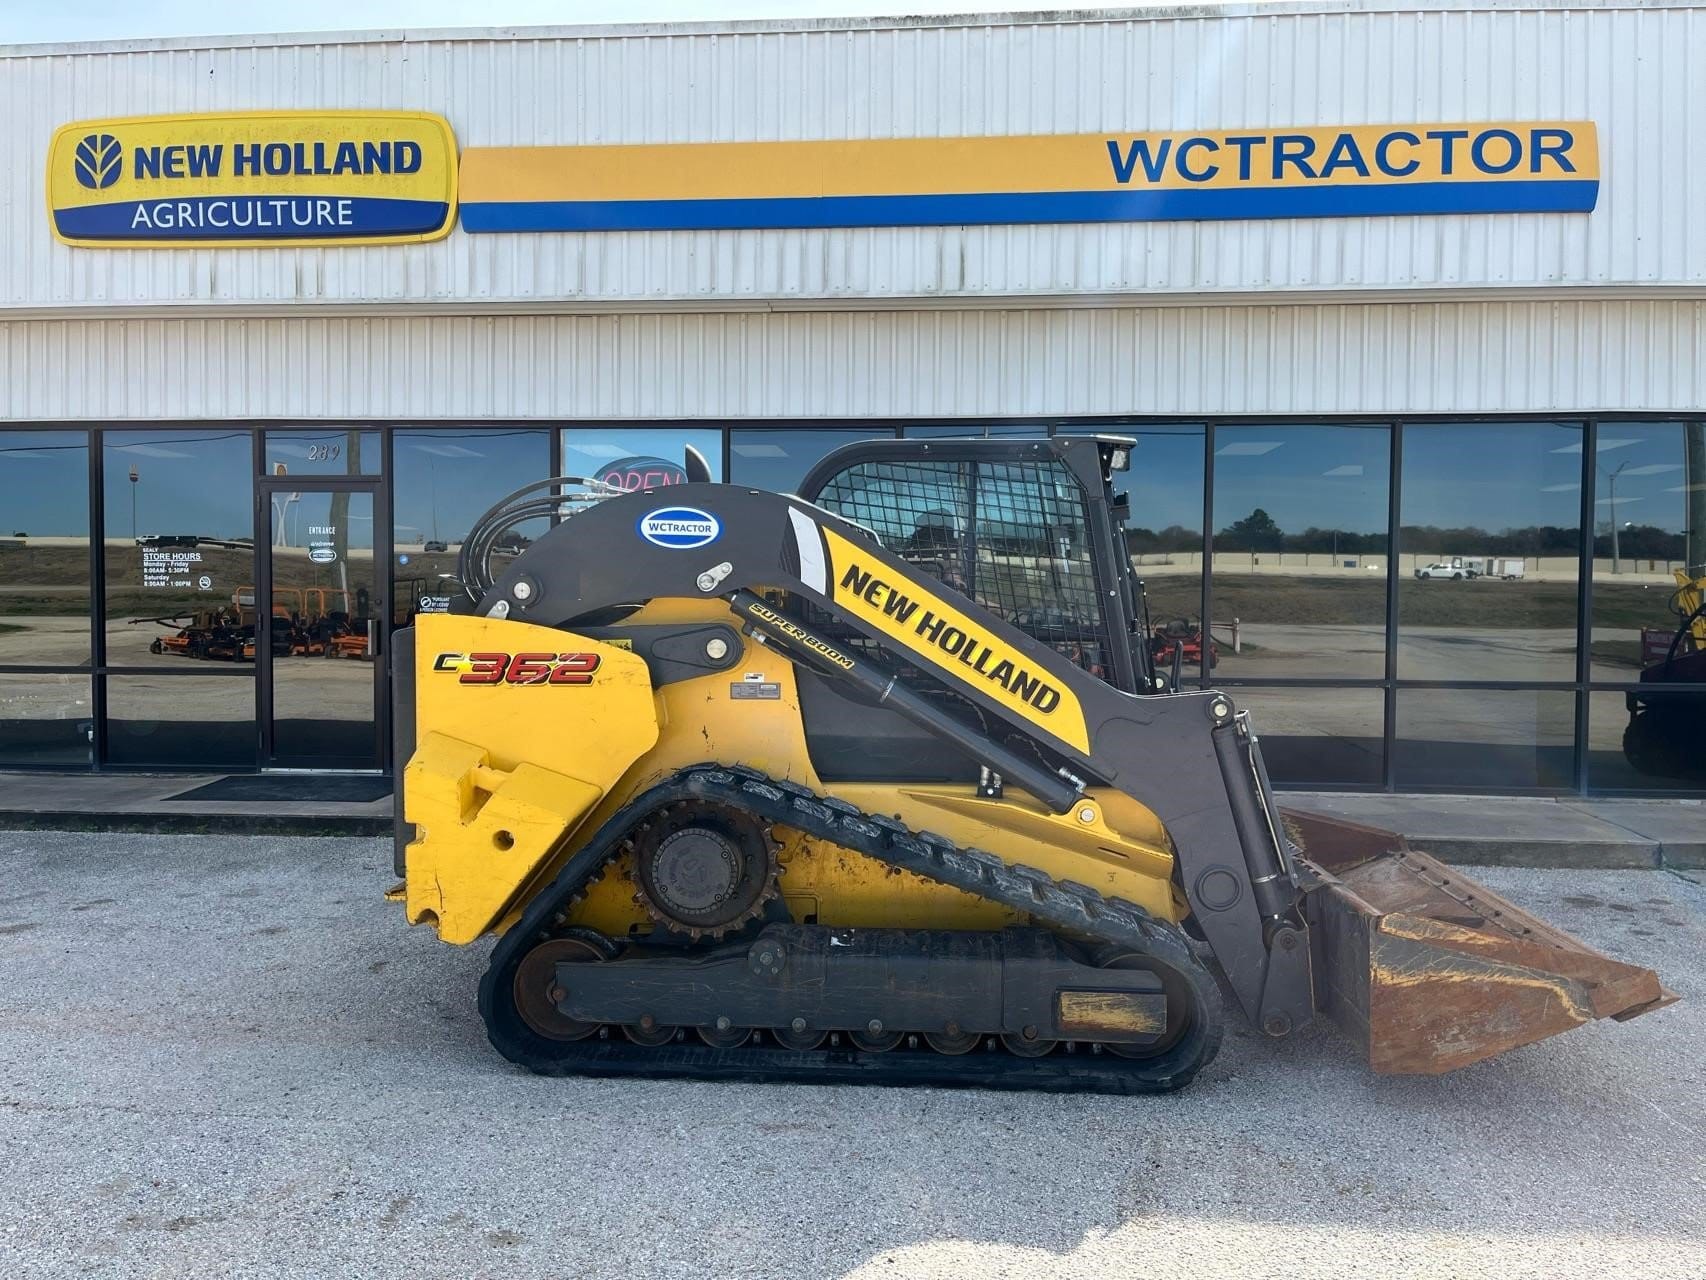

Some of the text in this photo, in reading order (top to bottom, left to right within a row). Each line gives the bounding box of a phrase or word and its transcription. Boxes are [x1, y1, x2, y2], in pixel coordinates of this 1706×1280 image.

[134, 140, 423, 179] NEW HOLLAND
[1106, 128, 1578, 184] WCTRACTOR
[131, 200, 354, 229] AGRICULTURE
[308, 444, 340, 461] 289
[308, 526, 336, 535] ENTRANCE
[143, 552, 201, 560] STORE HOURS
[841, 564, 1061, 714] NEW HOLLAND
